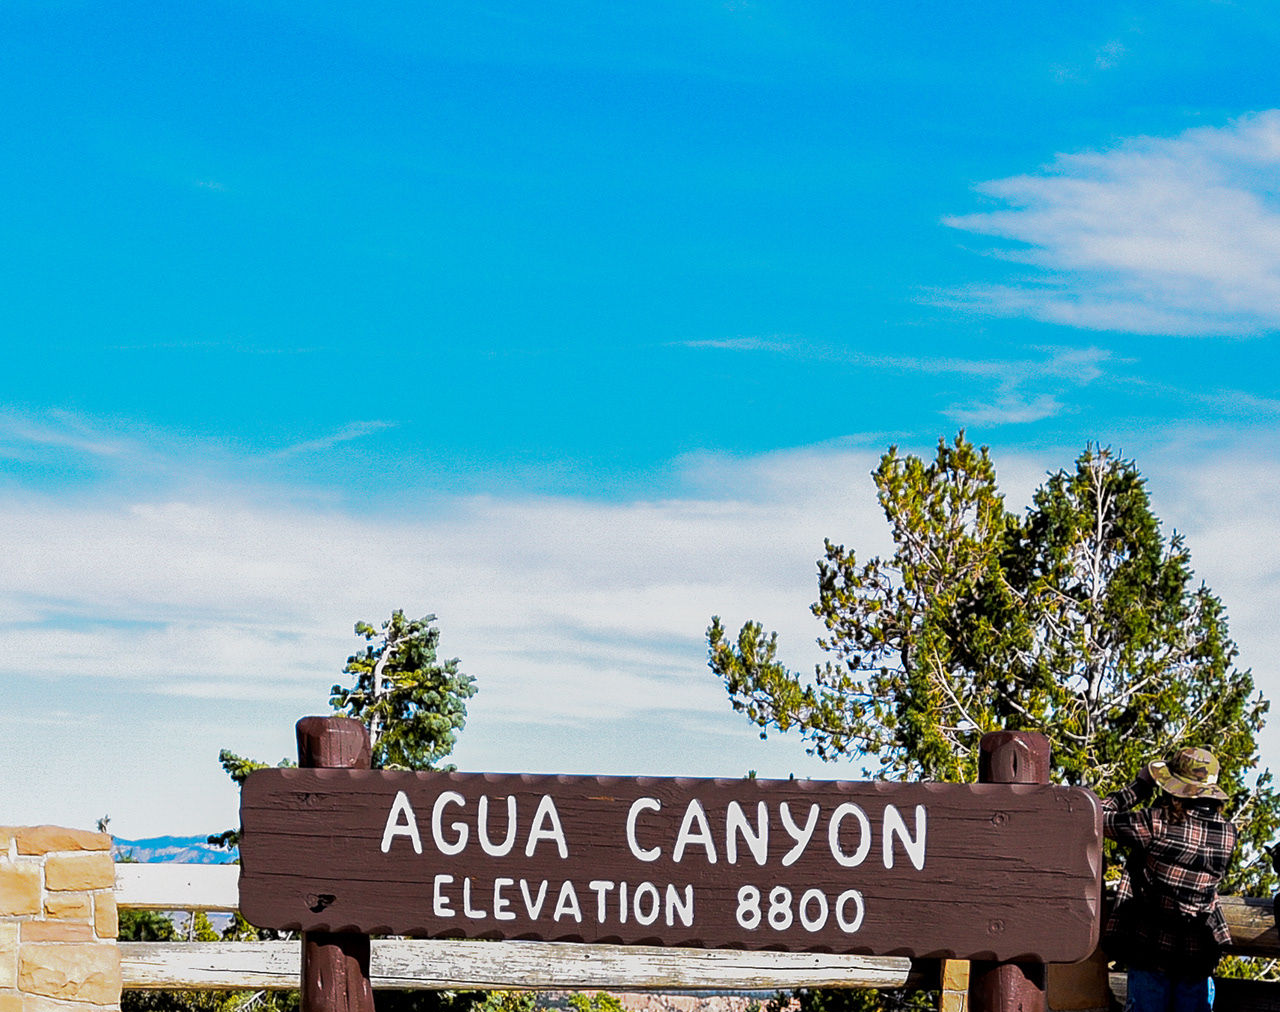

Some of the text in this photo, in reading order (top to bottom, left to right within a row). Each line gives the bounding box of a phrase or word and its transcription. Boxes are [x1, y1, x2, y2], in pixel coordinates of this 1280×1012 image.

[380, 790, 927, 871] AGUA CANYON
[432, 874, 865, 934] ELEVATION 8800
